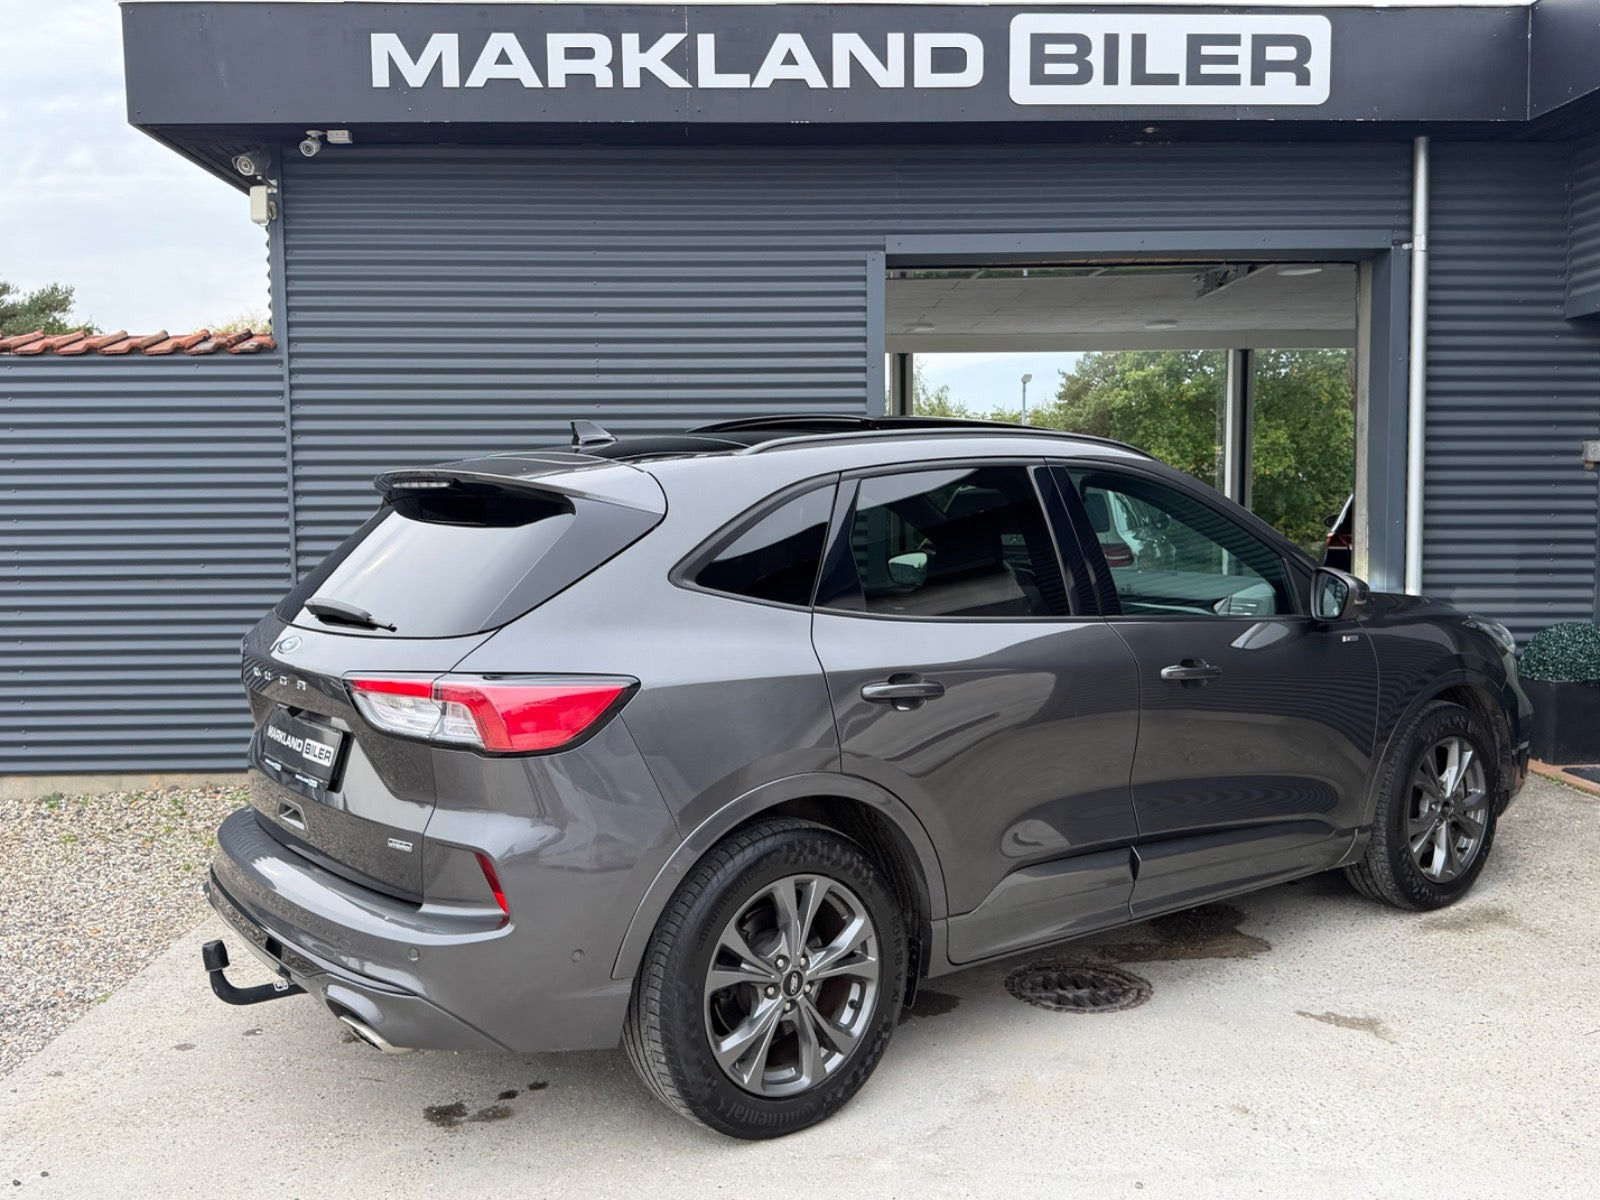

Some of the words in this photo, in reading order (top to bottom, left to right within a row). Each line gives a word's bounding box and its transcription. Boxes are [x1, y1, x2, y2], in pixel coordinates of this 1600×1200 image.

[371, 32, 984, 88] MARKLAND
[1029, 33, 1312, 86] BILER
[267, 724, 304, 753] MARKLAND
[304, 742, 332, 763] BILER
